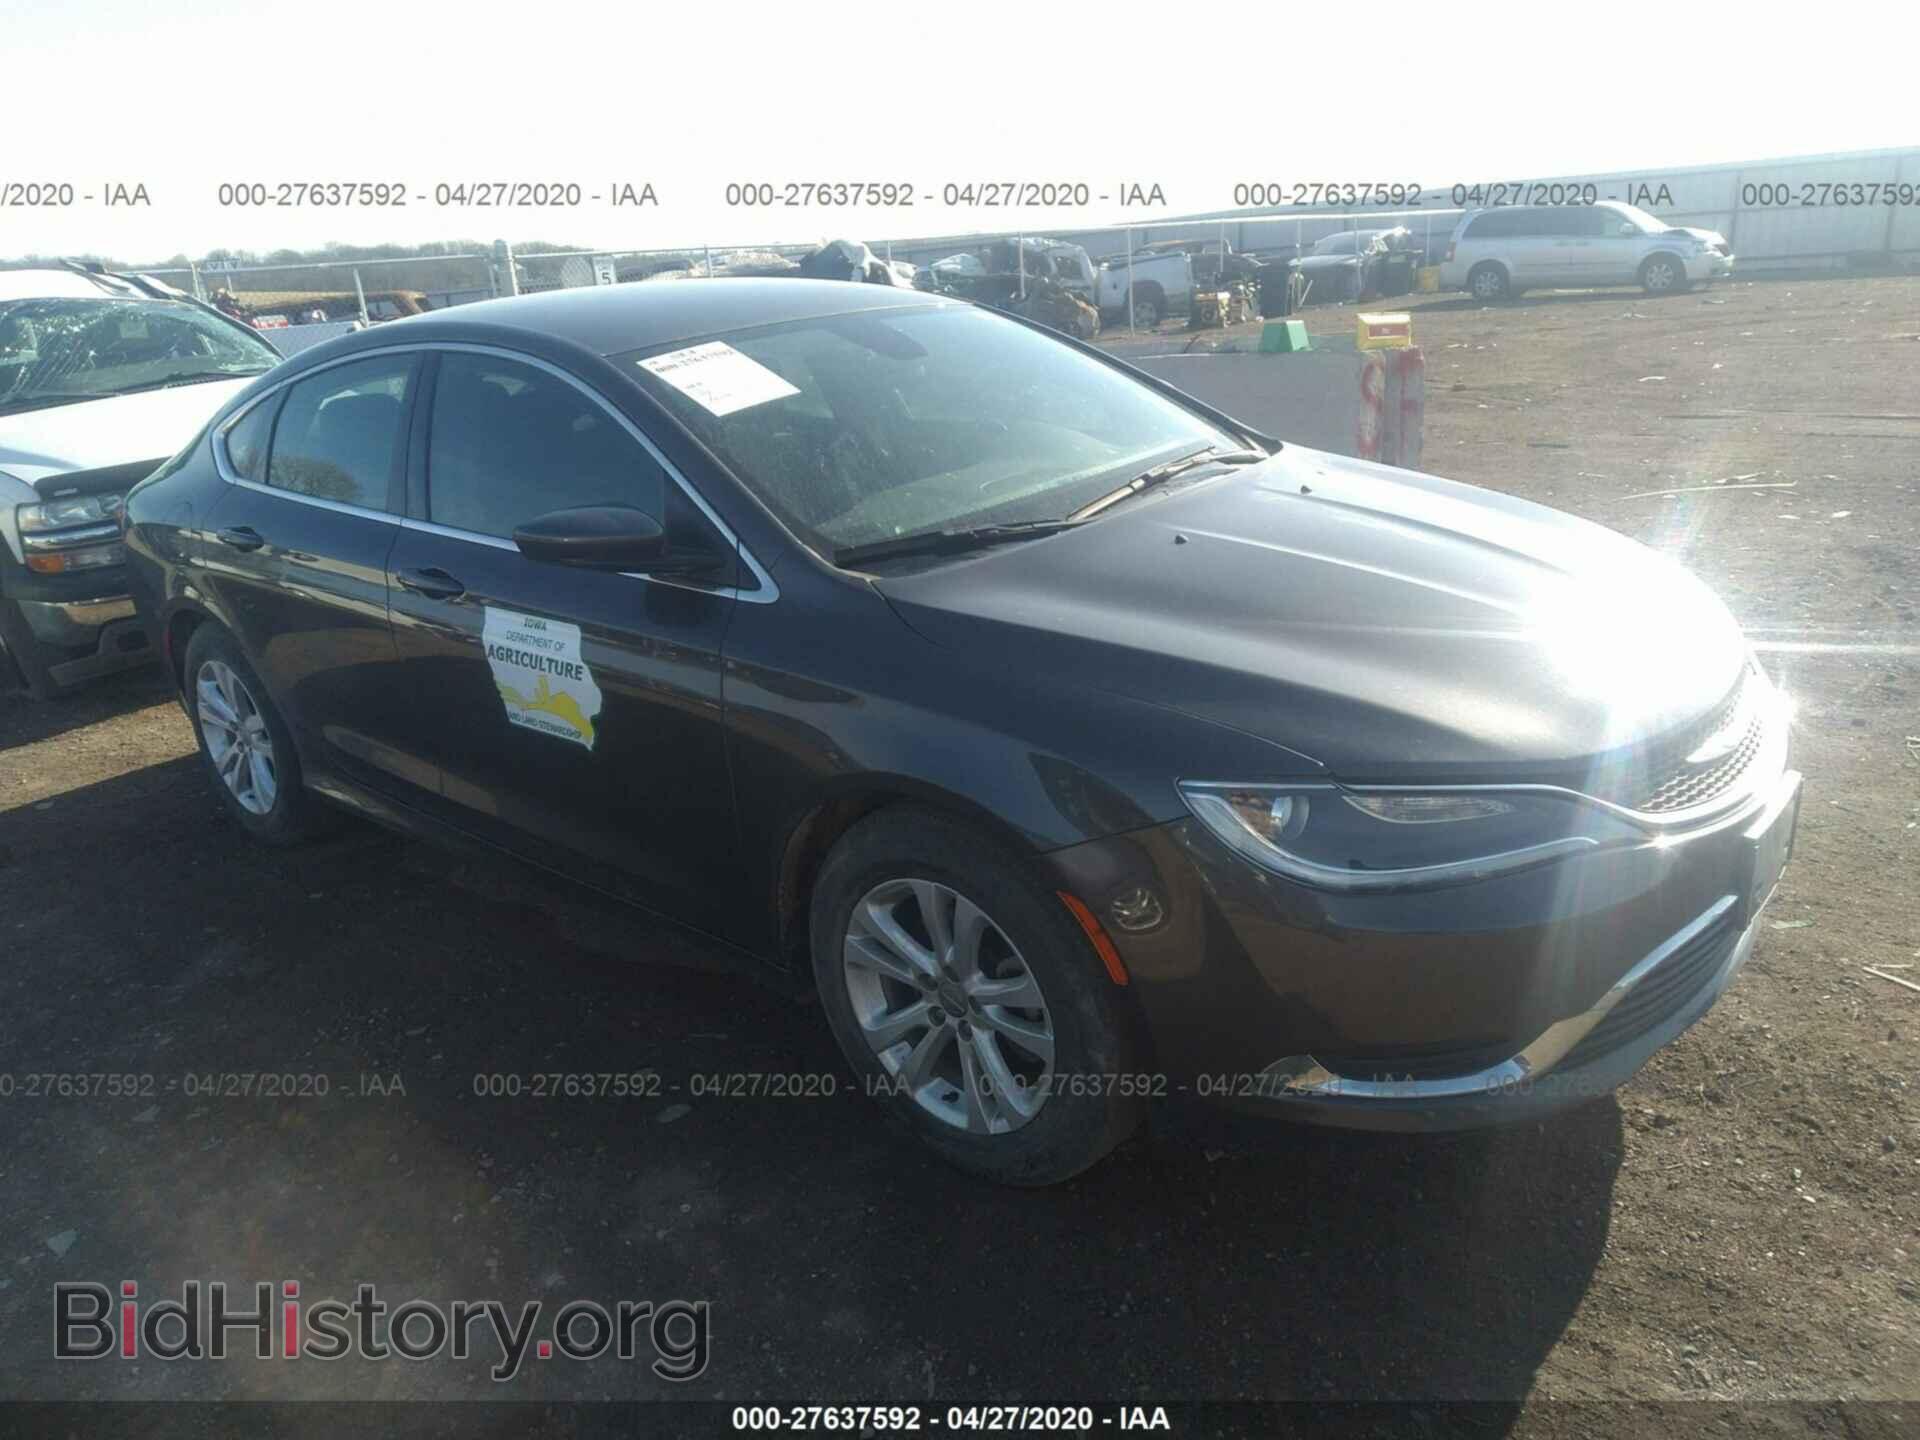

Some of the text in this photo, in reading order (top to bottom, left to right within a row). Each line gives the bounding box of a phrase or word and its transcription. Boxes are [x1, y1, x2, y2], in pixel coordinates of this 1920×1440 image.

[524, 617, 547, 631] IOWA
[505, 631, 566, 651] DEPARTMENT OF
[487, 644, 584, 682] AGRICULTURE
